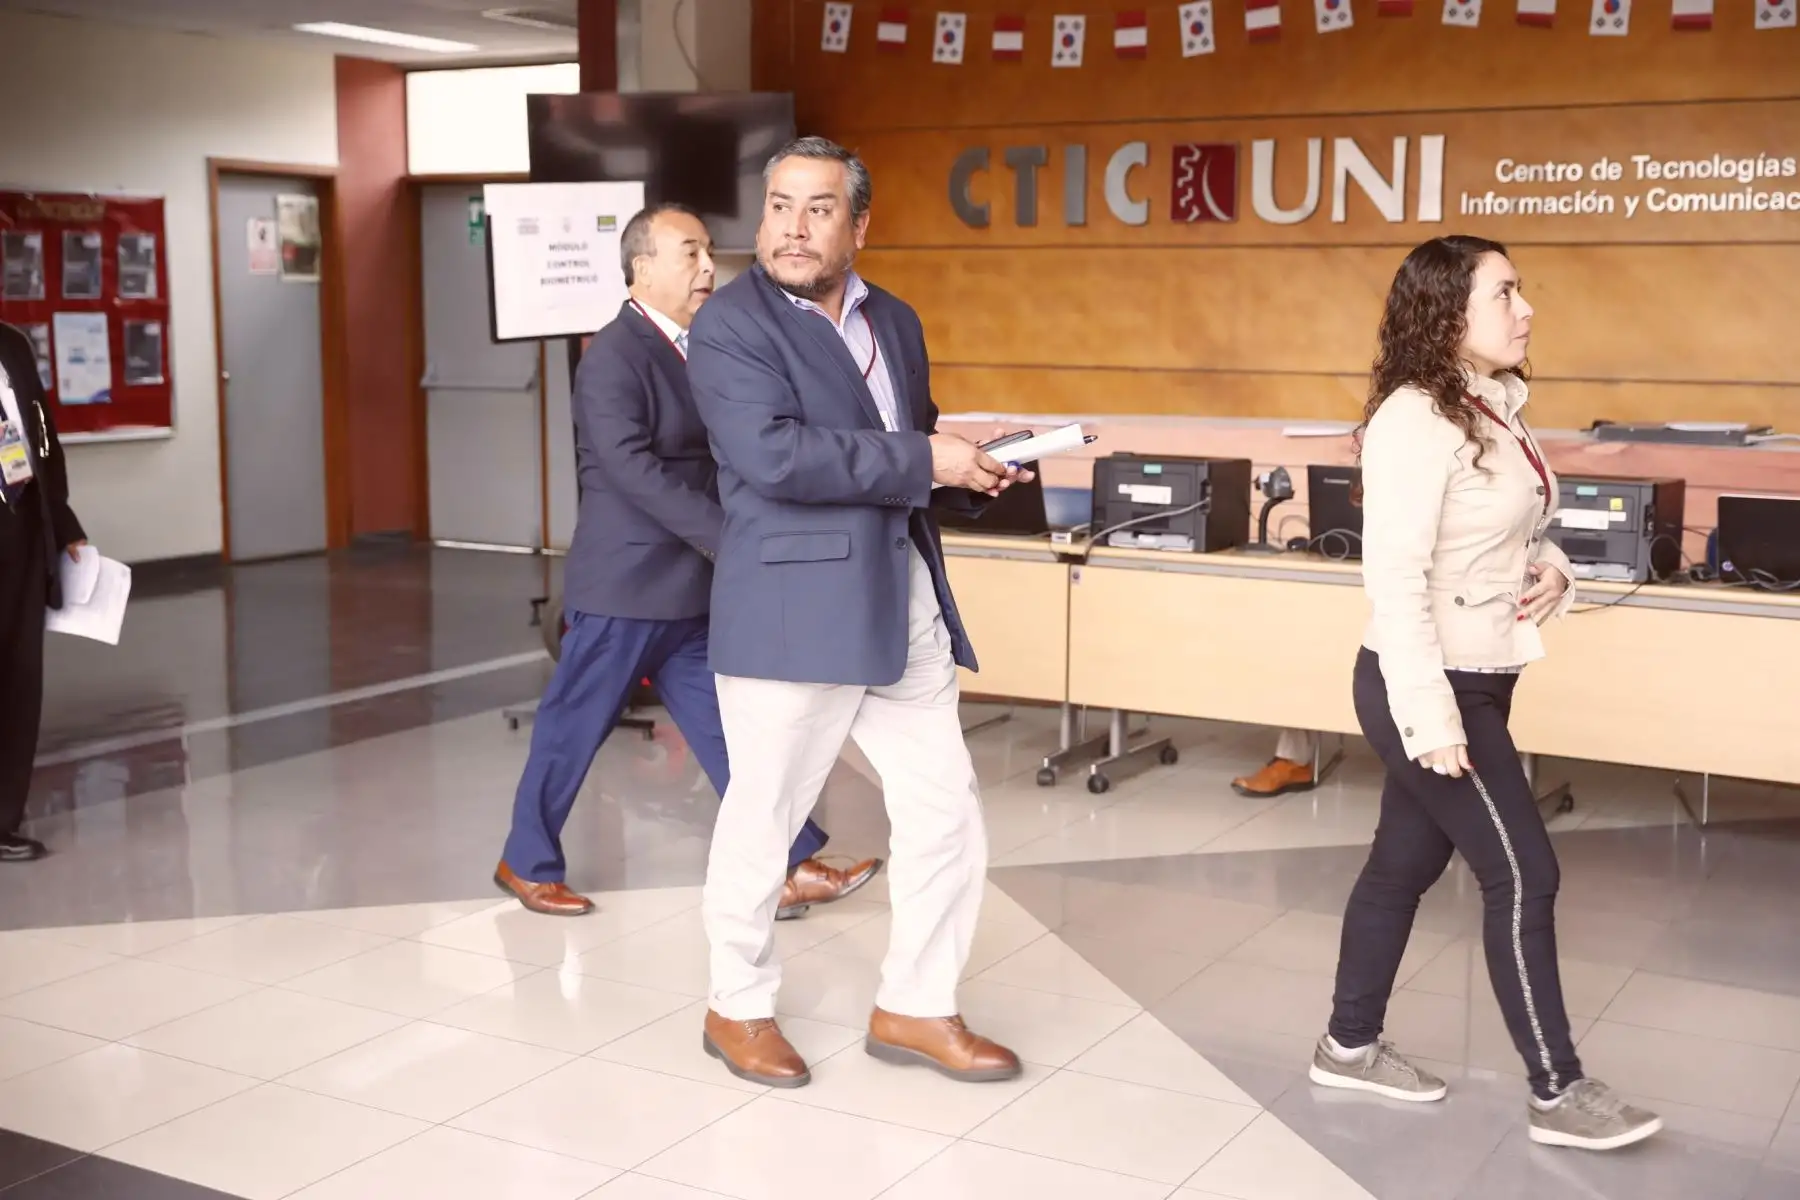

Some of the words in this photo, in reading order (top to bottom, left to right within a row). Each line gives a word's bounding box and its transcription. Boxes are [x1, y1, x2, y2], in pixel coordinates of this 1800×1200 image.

[948, 141, 1149, 228] CTIC
[1252, 134, 1444, 224] UNI
[1496, 158, 1583, 183] Centro
[1591, 157, 1623, 181] de
[1631, 152, 1797, 183] Tecnologías
[1461, 189, 1614, 215] Información
[1624, 195, 1640, 218] y
